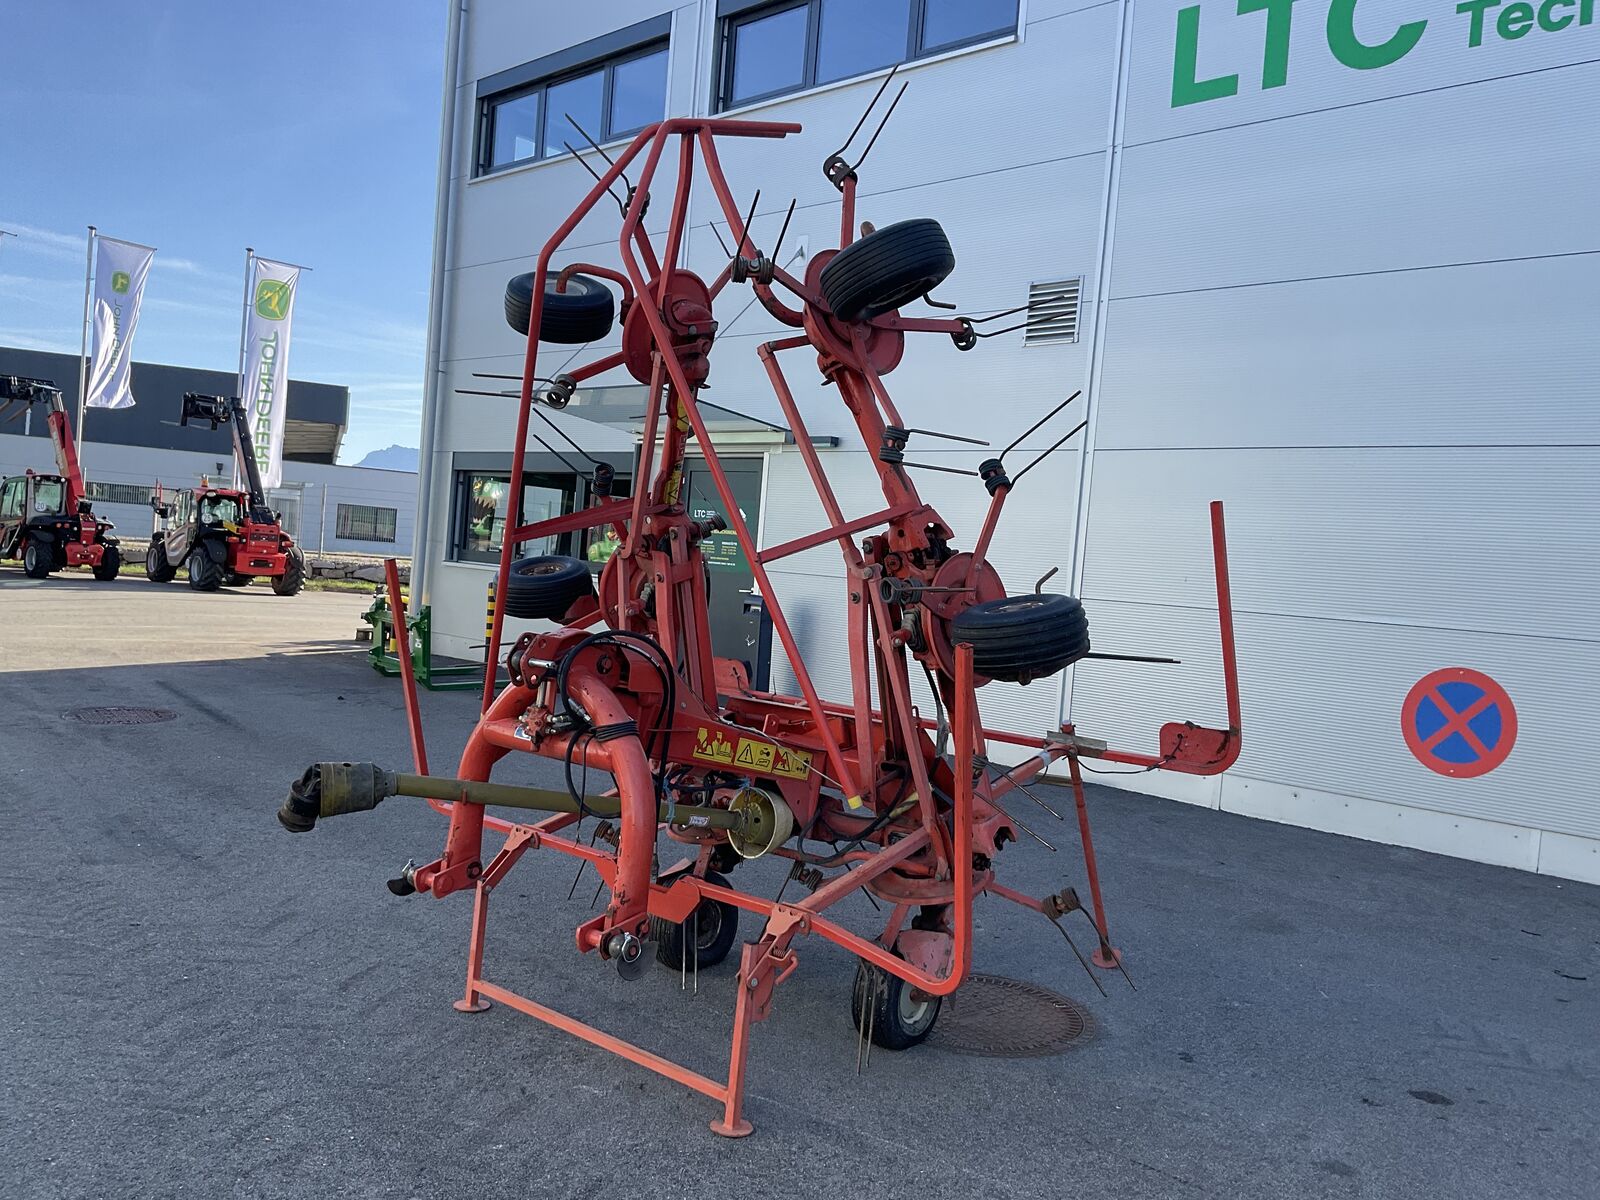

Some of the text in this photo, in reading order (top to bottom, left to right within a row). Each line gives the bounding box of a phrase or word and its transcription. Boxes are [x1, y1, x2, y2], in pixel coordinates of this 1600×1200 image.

[1171, 0, 1428, 108] LTC
[113, 298, 122, 334] JOHN
[694, 509, 706, 518] LTC
